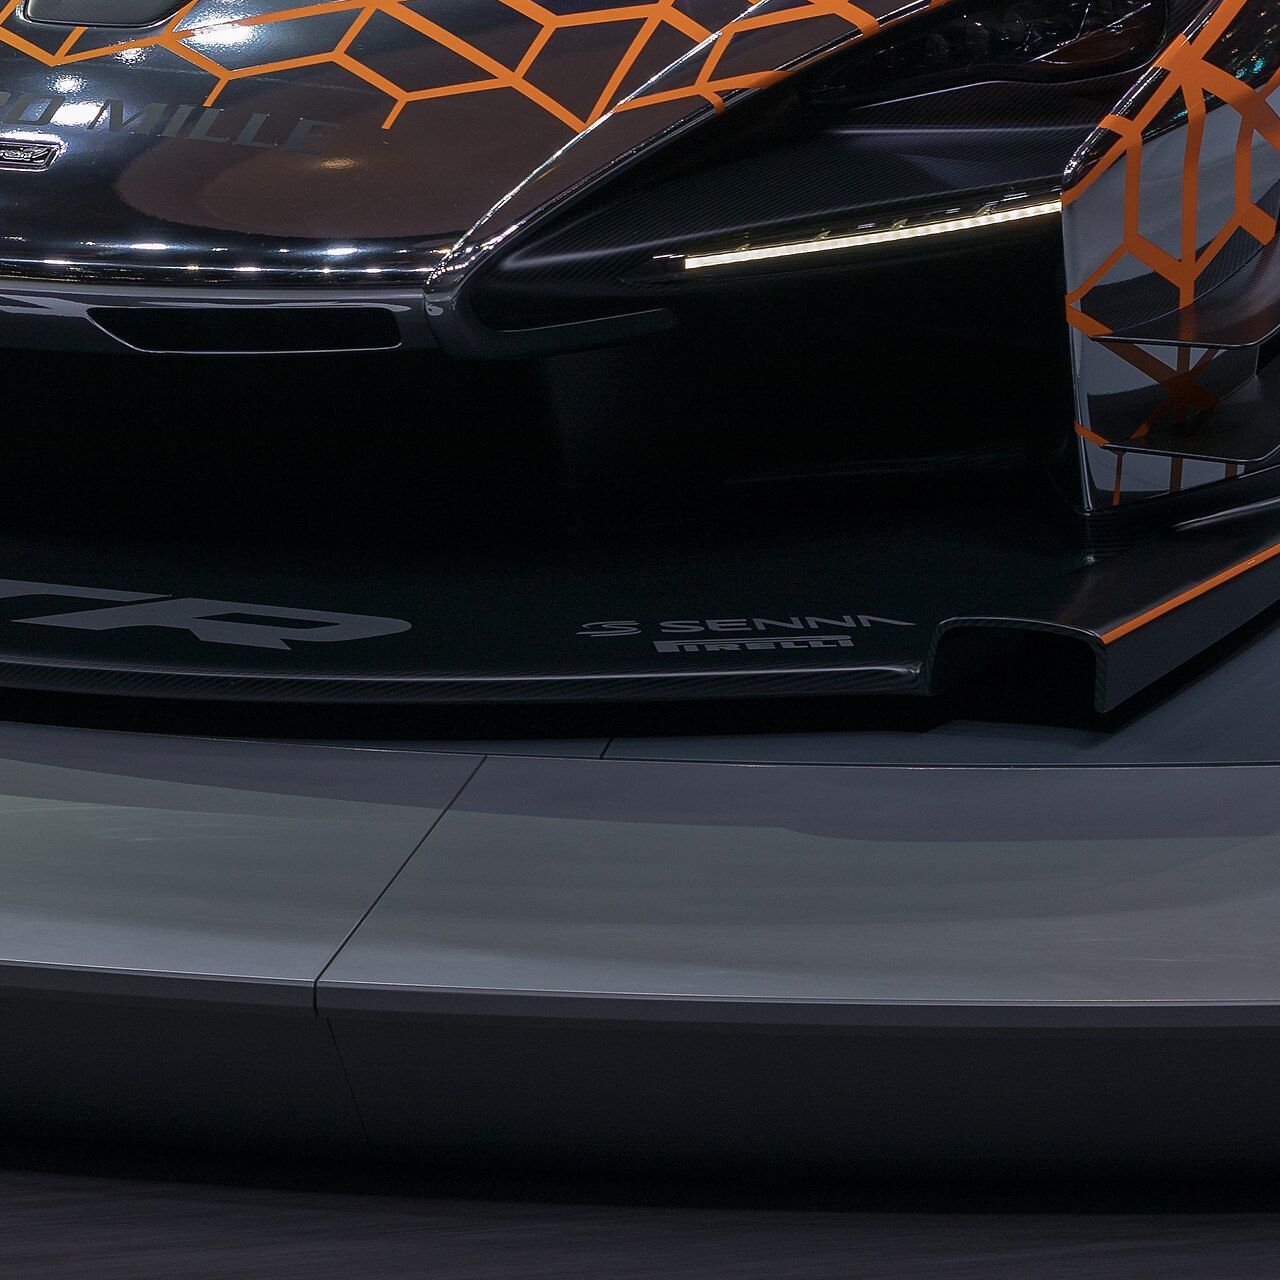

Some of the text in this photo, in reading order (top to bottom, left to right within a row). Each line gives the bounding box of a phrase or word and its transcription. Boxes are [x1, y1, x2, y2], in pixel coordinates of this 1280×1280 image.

[96, 97, 342, 154] MILLE
[659, 614, 917, 633] SENNA
[652, 634, 855, 653] PIRELLI
